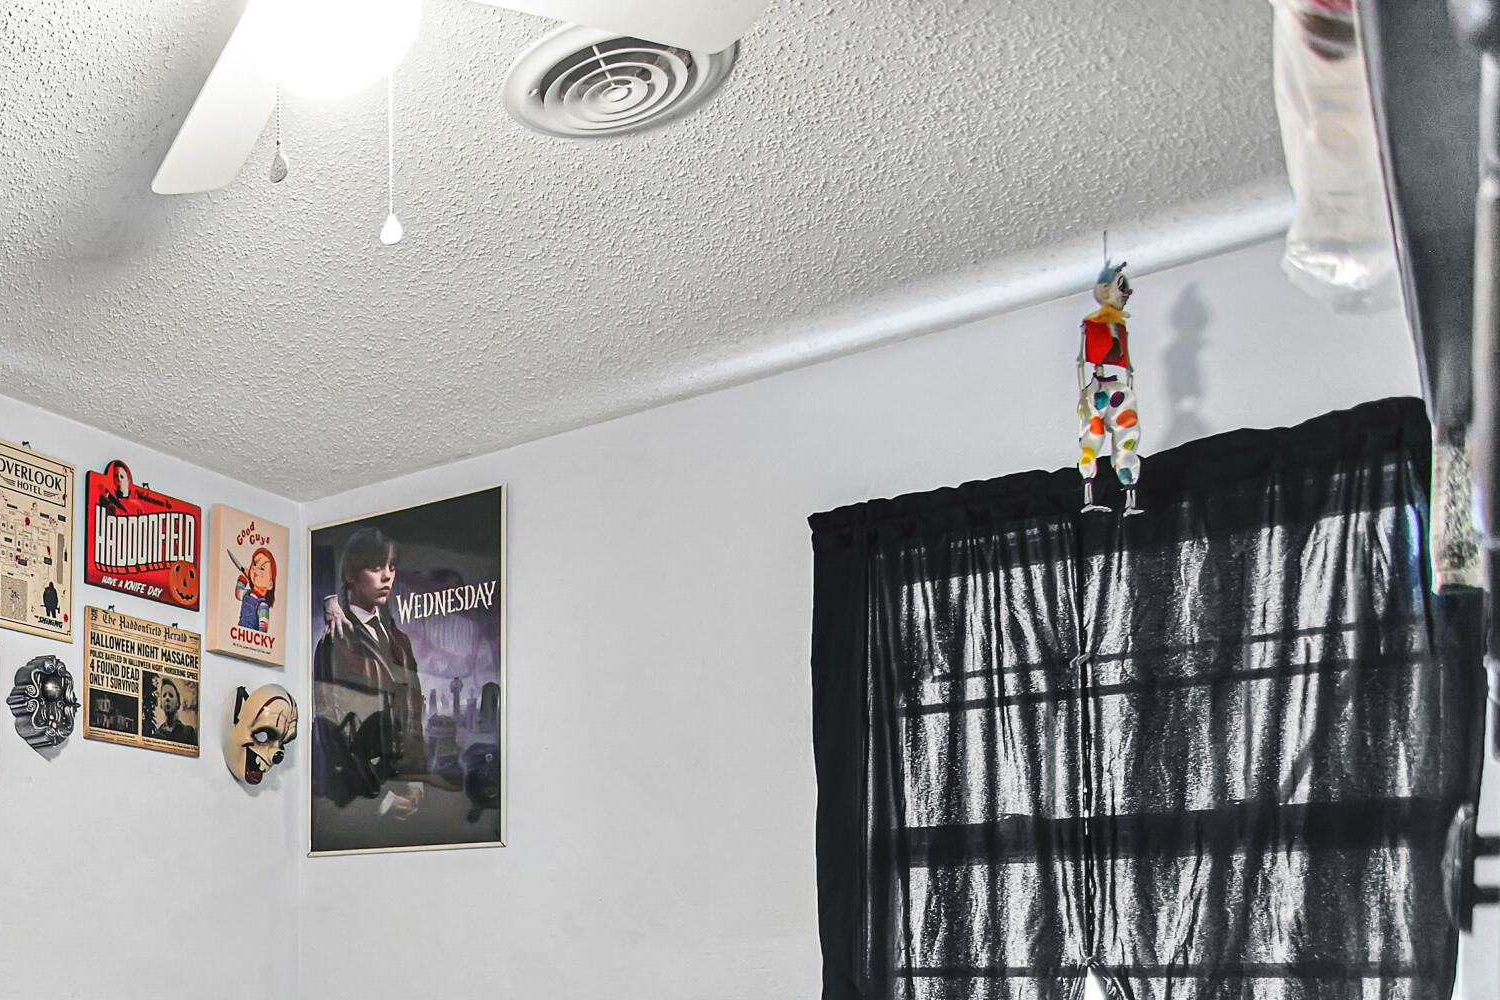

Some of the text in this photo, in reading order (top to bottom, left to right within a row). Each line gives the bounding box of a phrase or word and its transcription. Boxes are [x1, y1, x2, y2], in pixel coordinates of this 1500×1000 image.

[17, 480, 42, 496] HOTEL
[95, 505, 195, 567] HADDONFIELD
[236, 521, 255, 546] Good
[250, 534, 270, 546] Guys
[102, 576, 163, 598] HAVE A KNIFE DAY
[396, 581, 496, 624] WEDNESDAY
[102, 610, 117, 626] The
[119, 615, 162, 637] Haddonfield
[164, 628, 187, 643] Herald
[230, 626, 276, 649] CHUCKY
[90, 631, 199, 669] HALLOWEEN NIGHT MASSACRE
[90, 659, 139, 681] 4 FOUND DEAD
[89, 673, 104, 686] ONLY
[110, 677, 139, 694] SURVIVOR
